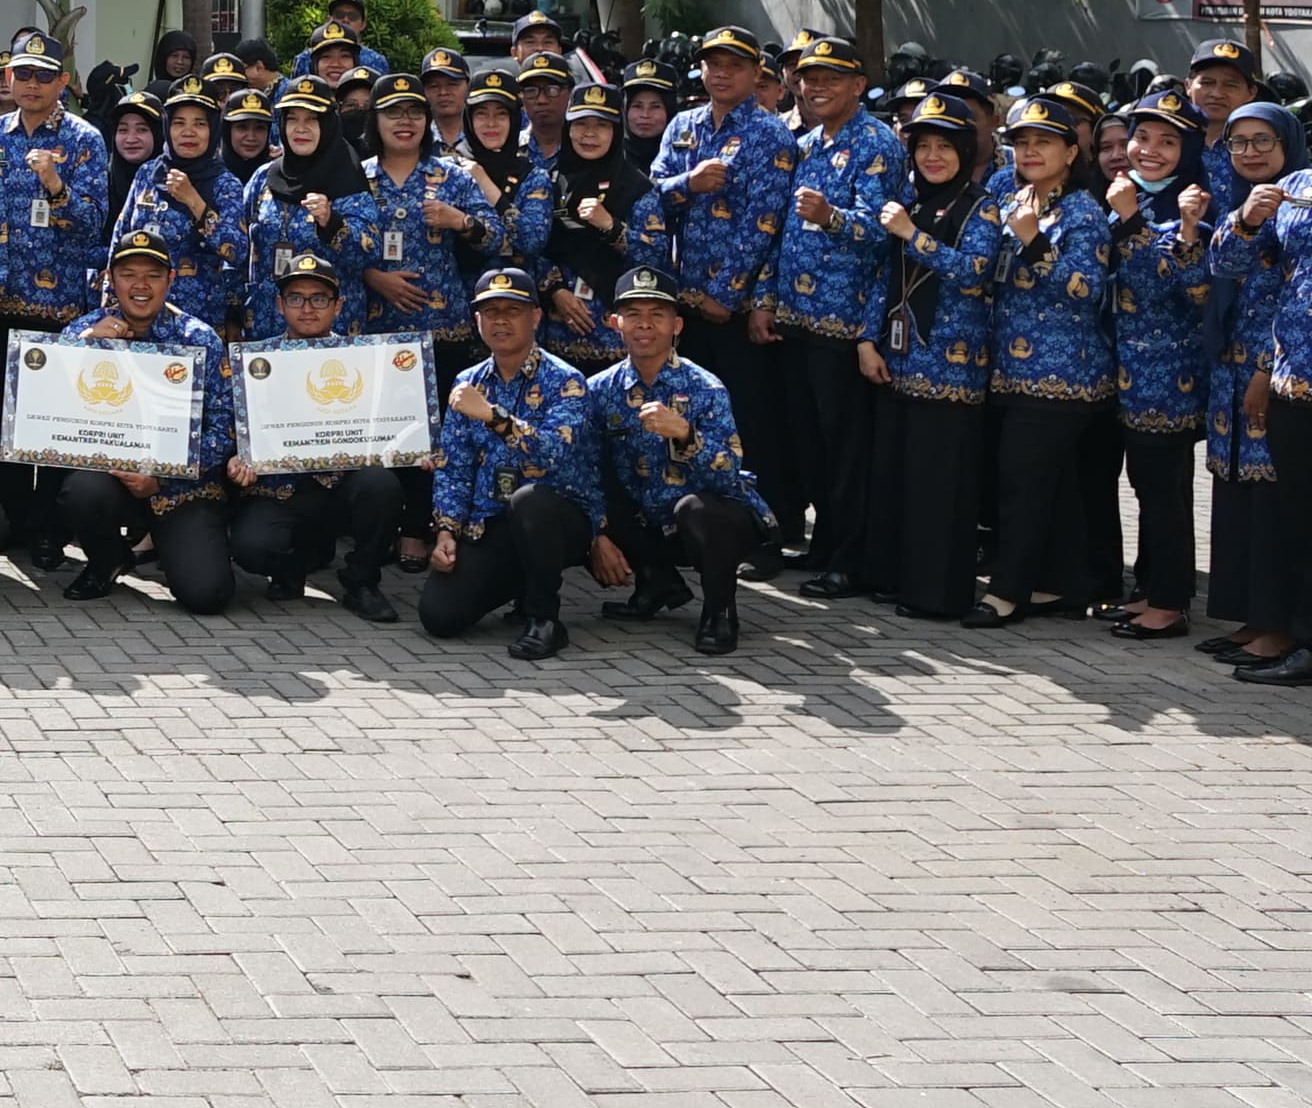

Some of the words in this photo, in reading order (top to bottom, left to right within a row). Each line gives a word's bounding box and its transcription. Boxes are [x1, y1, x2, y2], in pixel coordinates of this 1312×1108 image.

[78, 429, 107, 438] KORPRI
[108, 431, 125, 439] UNIT
[315, 429, 344, 439] KORPRI
[344, 428, 364, 437] UNIT
